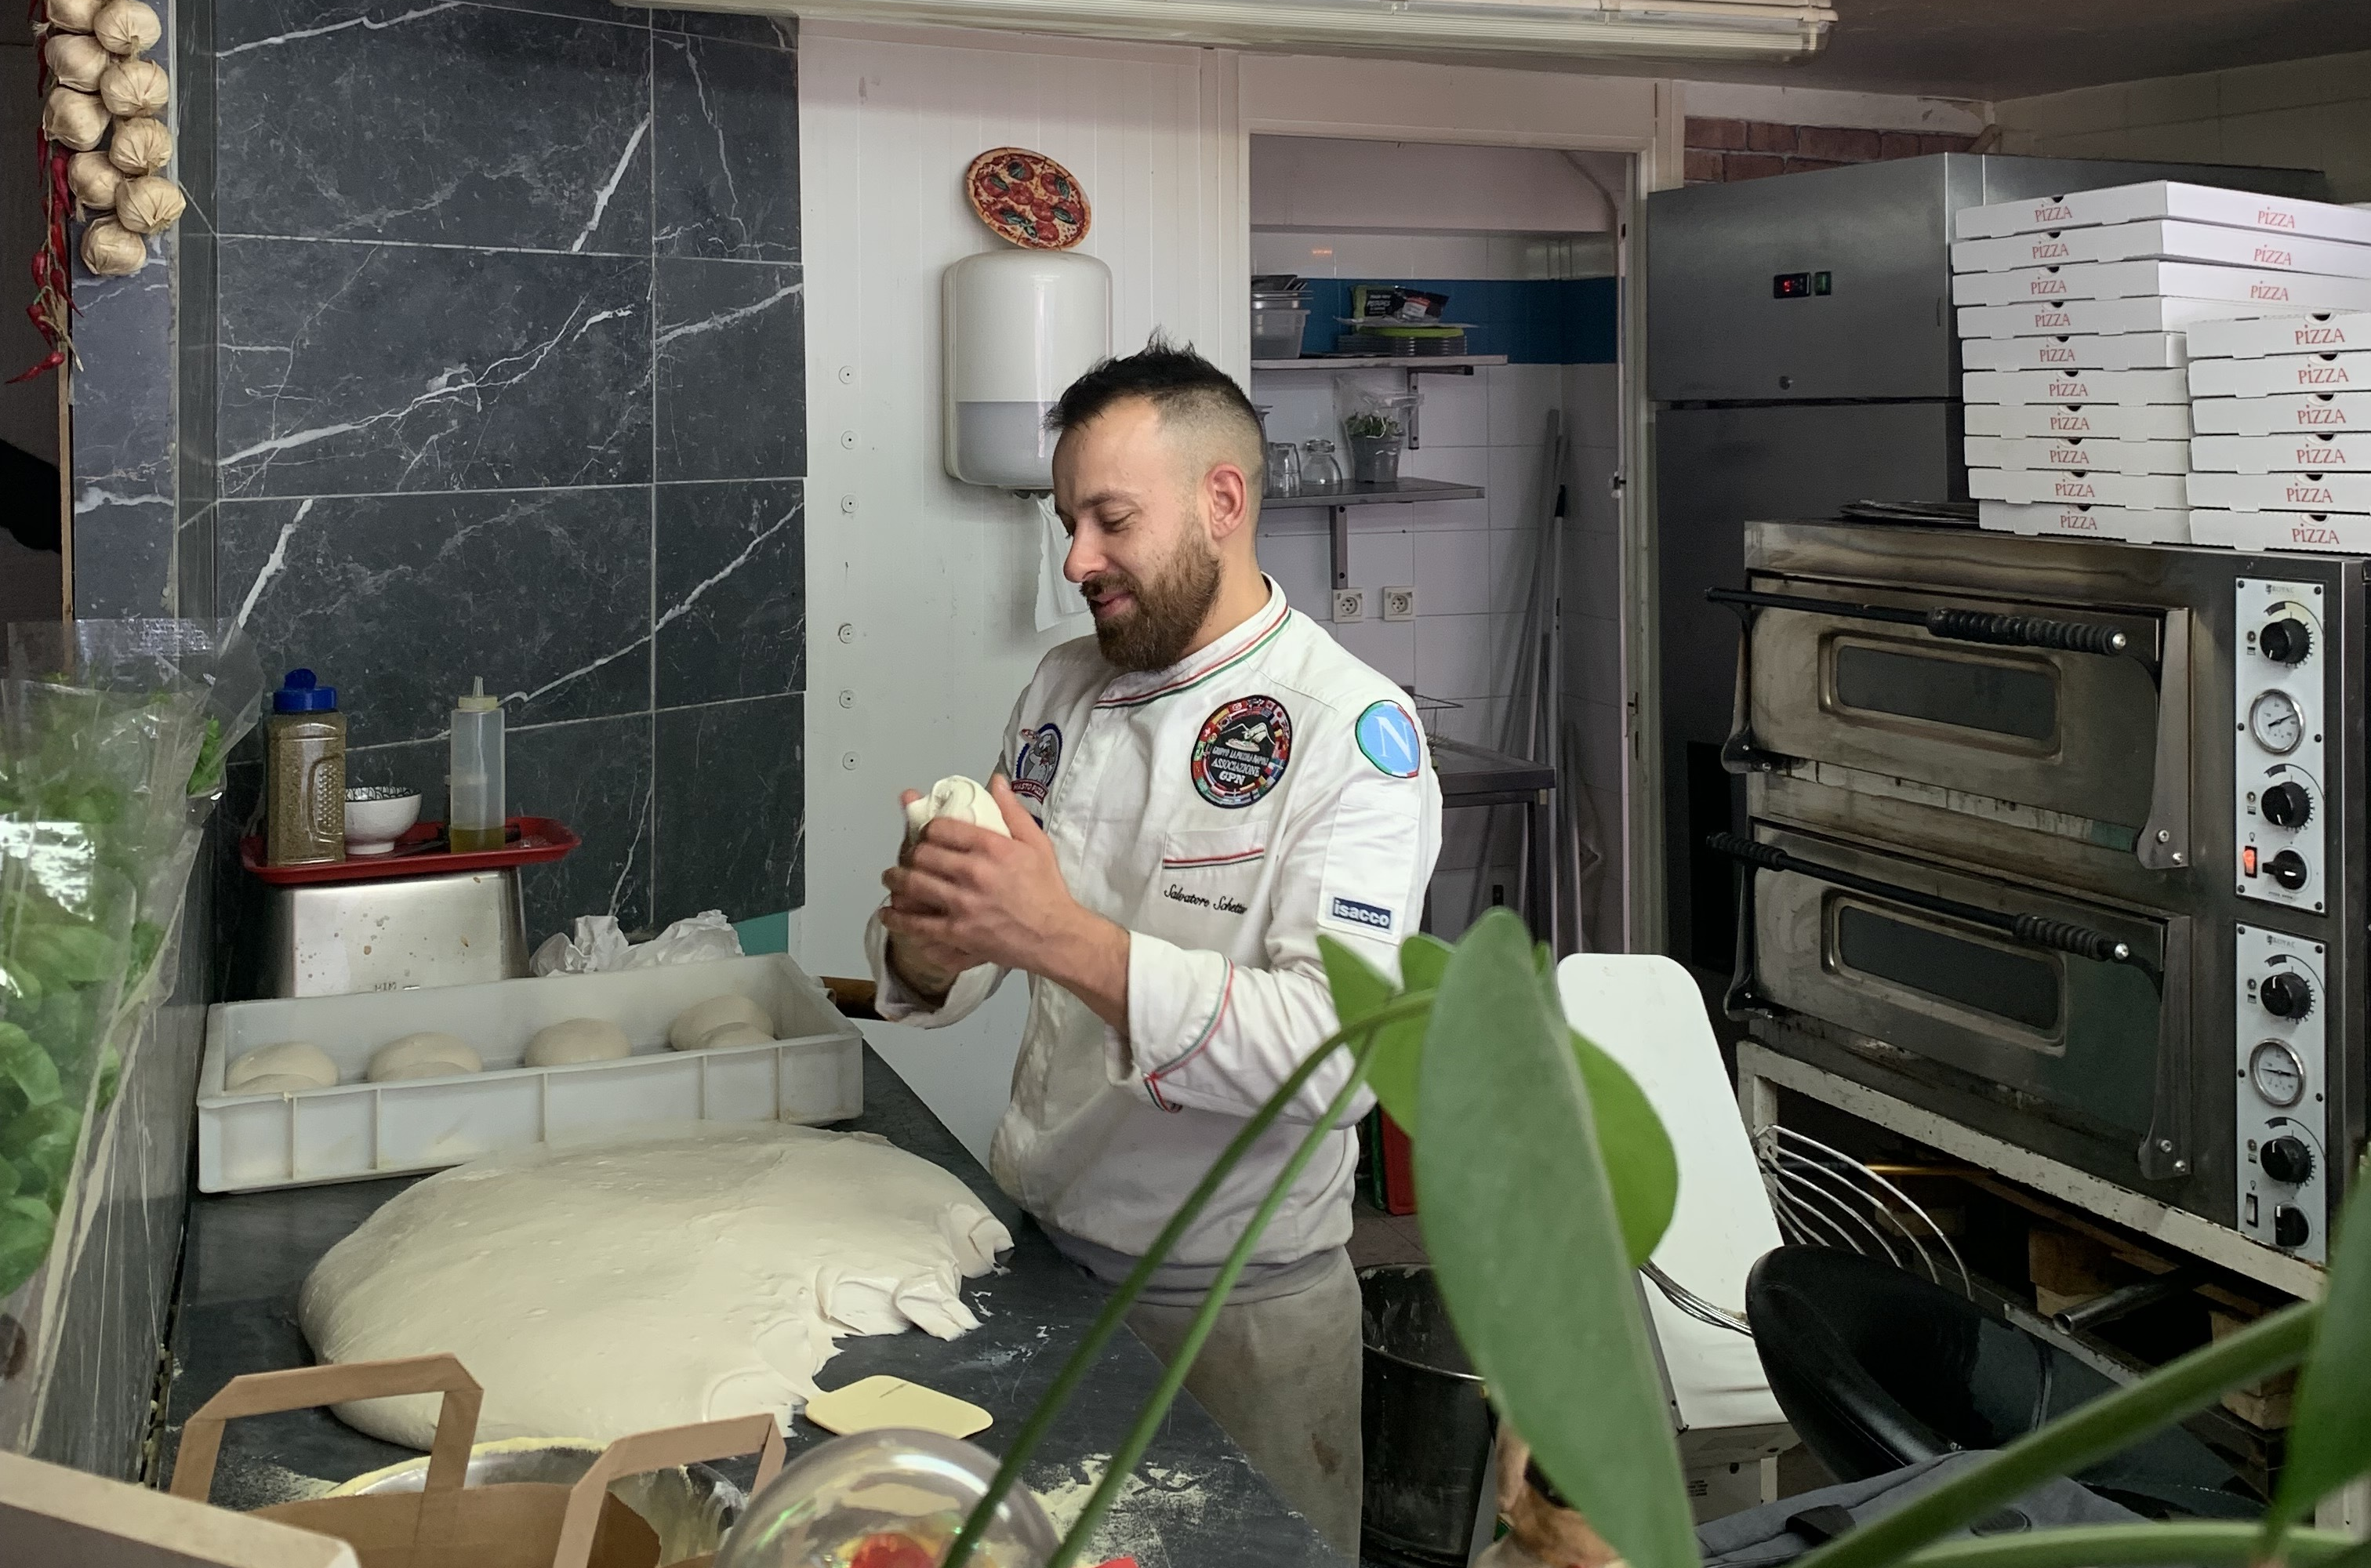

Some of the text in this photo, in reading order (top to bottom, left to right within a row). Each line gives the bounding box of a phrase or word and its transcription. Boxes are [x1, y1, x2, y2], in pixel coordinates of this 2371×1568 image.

[1374, 715, 1412, 764] N
[1211, 758, 1261, 777] ASSOCIAZIONE
[1218, 771, 1245, 785] GPN
[1164, 884, 1210, 907] Salvatore
[1334, 899, 1390, 927] isacco
